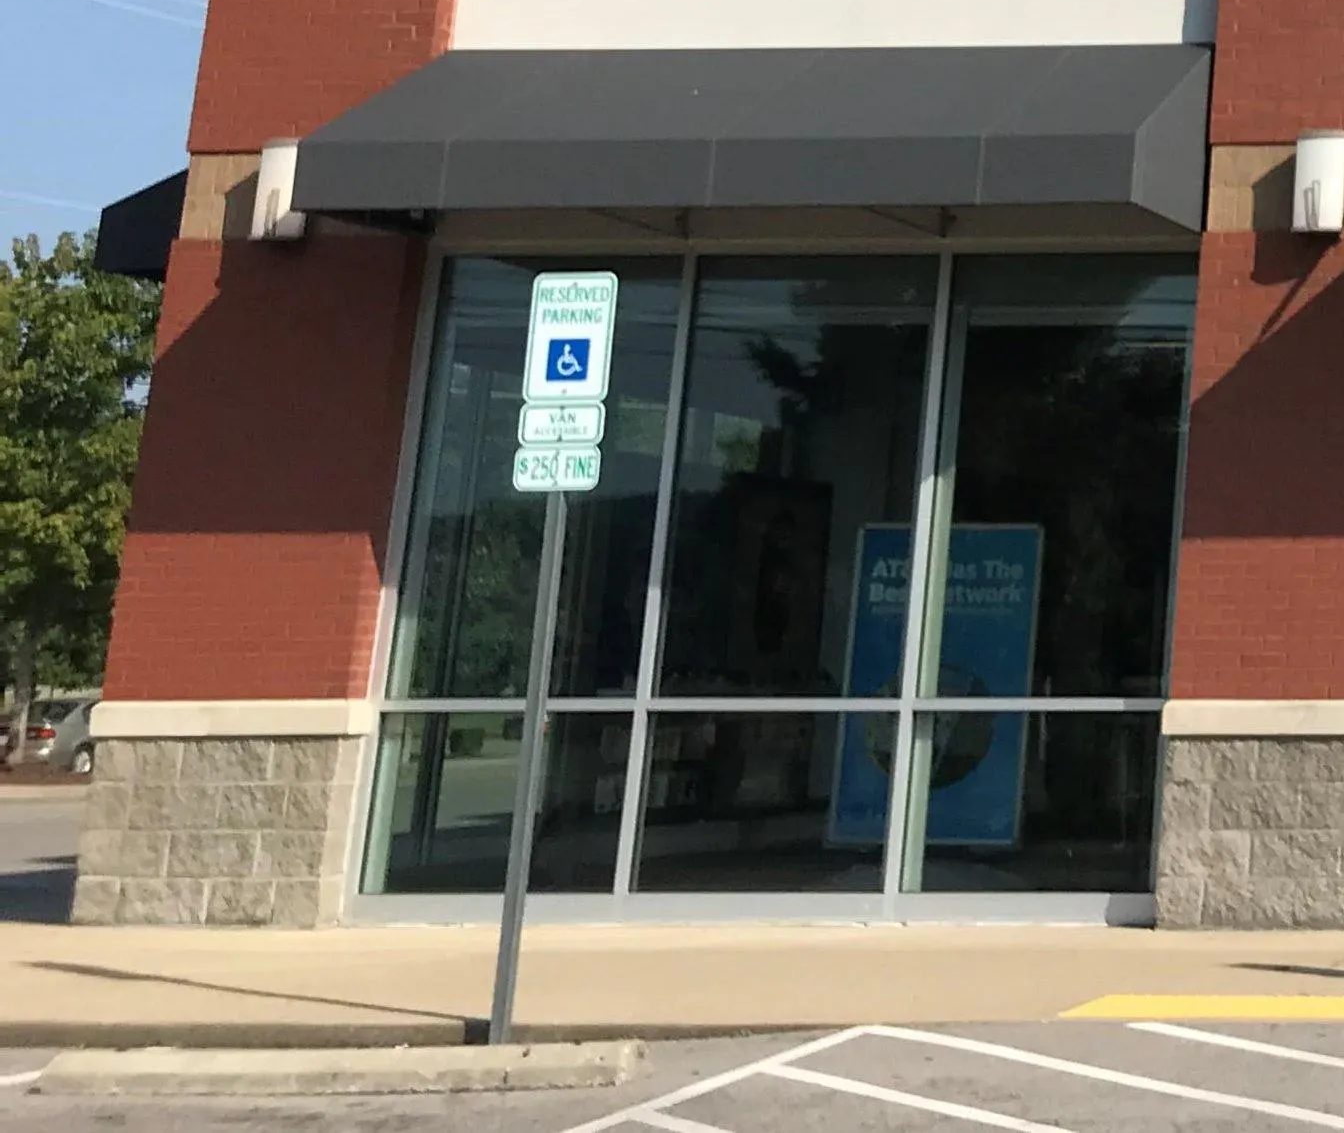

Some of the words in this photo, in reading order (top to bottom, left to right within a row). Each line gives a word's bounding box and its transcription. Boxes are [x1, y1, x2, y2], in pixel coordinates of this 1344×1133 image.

[539, 286, 610, 303] RESERVED
[541, 307, 603, 325] PARKING
[549, 412, 577, 424] VAN
[565, 455, 597, 480] FINE
[982, 559, 1025, 580] The
[868, 583, 909, 602] Bes
[944, 584, 1022, 603] etwork
